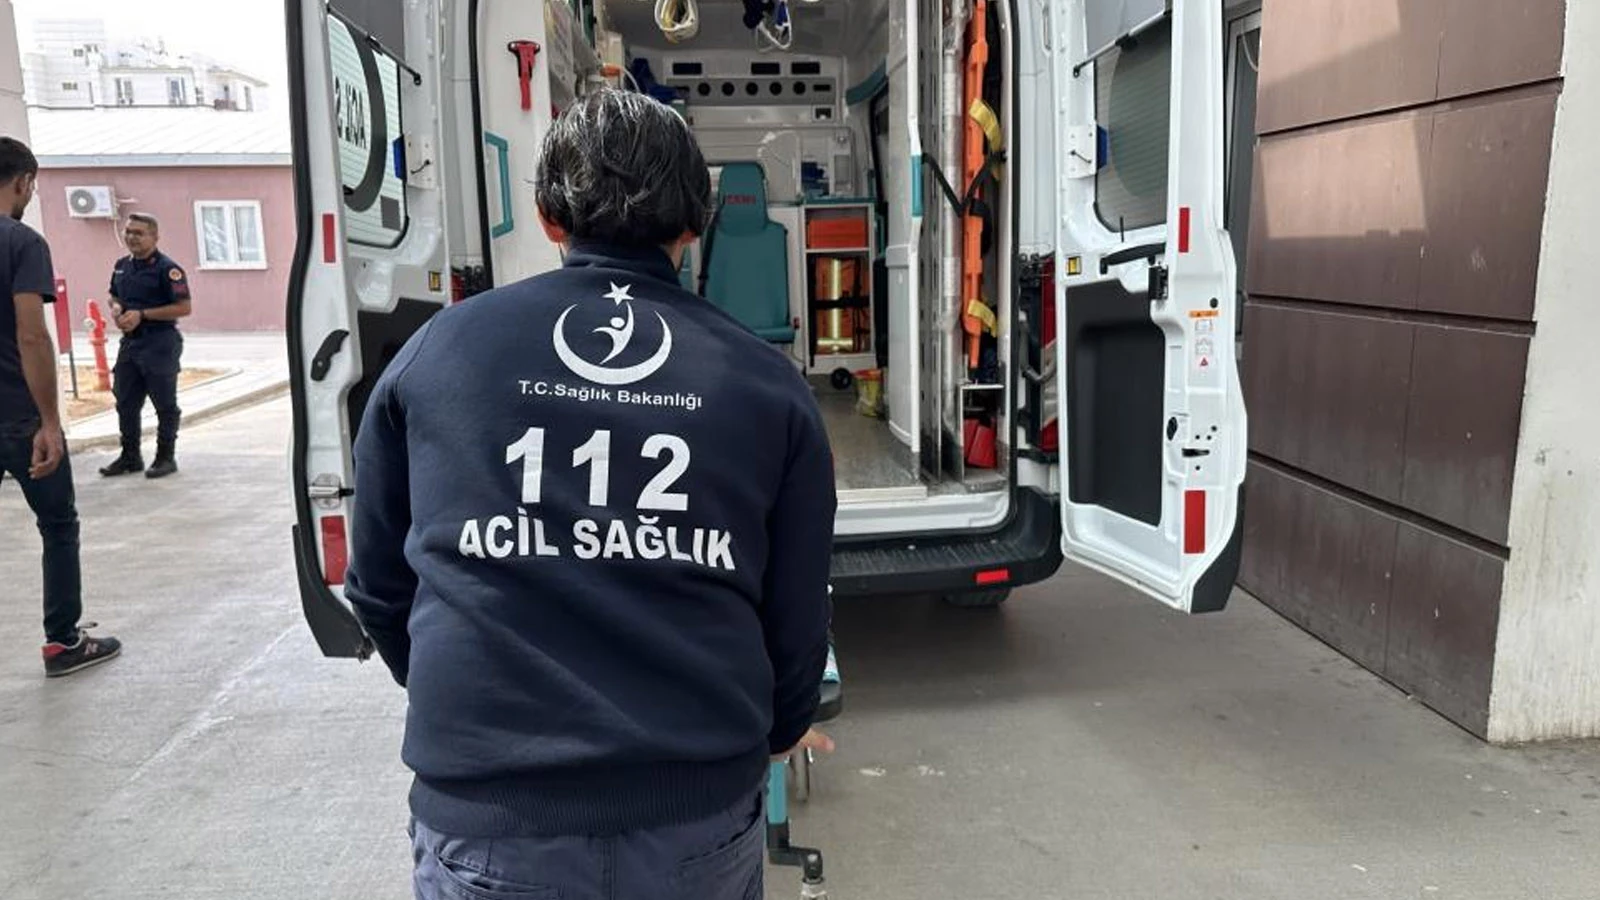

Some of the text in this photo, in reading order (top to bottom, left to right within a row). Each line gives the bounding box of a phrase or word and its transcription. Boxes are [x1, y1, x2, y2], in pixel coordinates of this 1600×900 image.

[617, 389, 702, 411] Bakanlığı
[505, 427, 691, 511] 112
[458, 507, 735, 571] ACİL SAĞLIK
